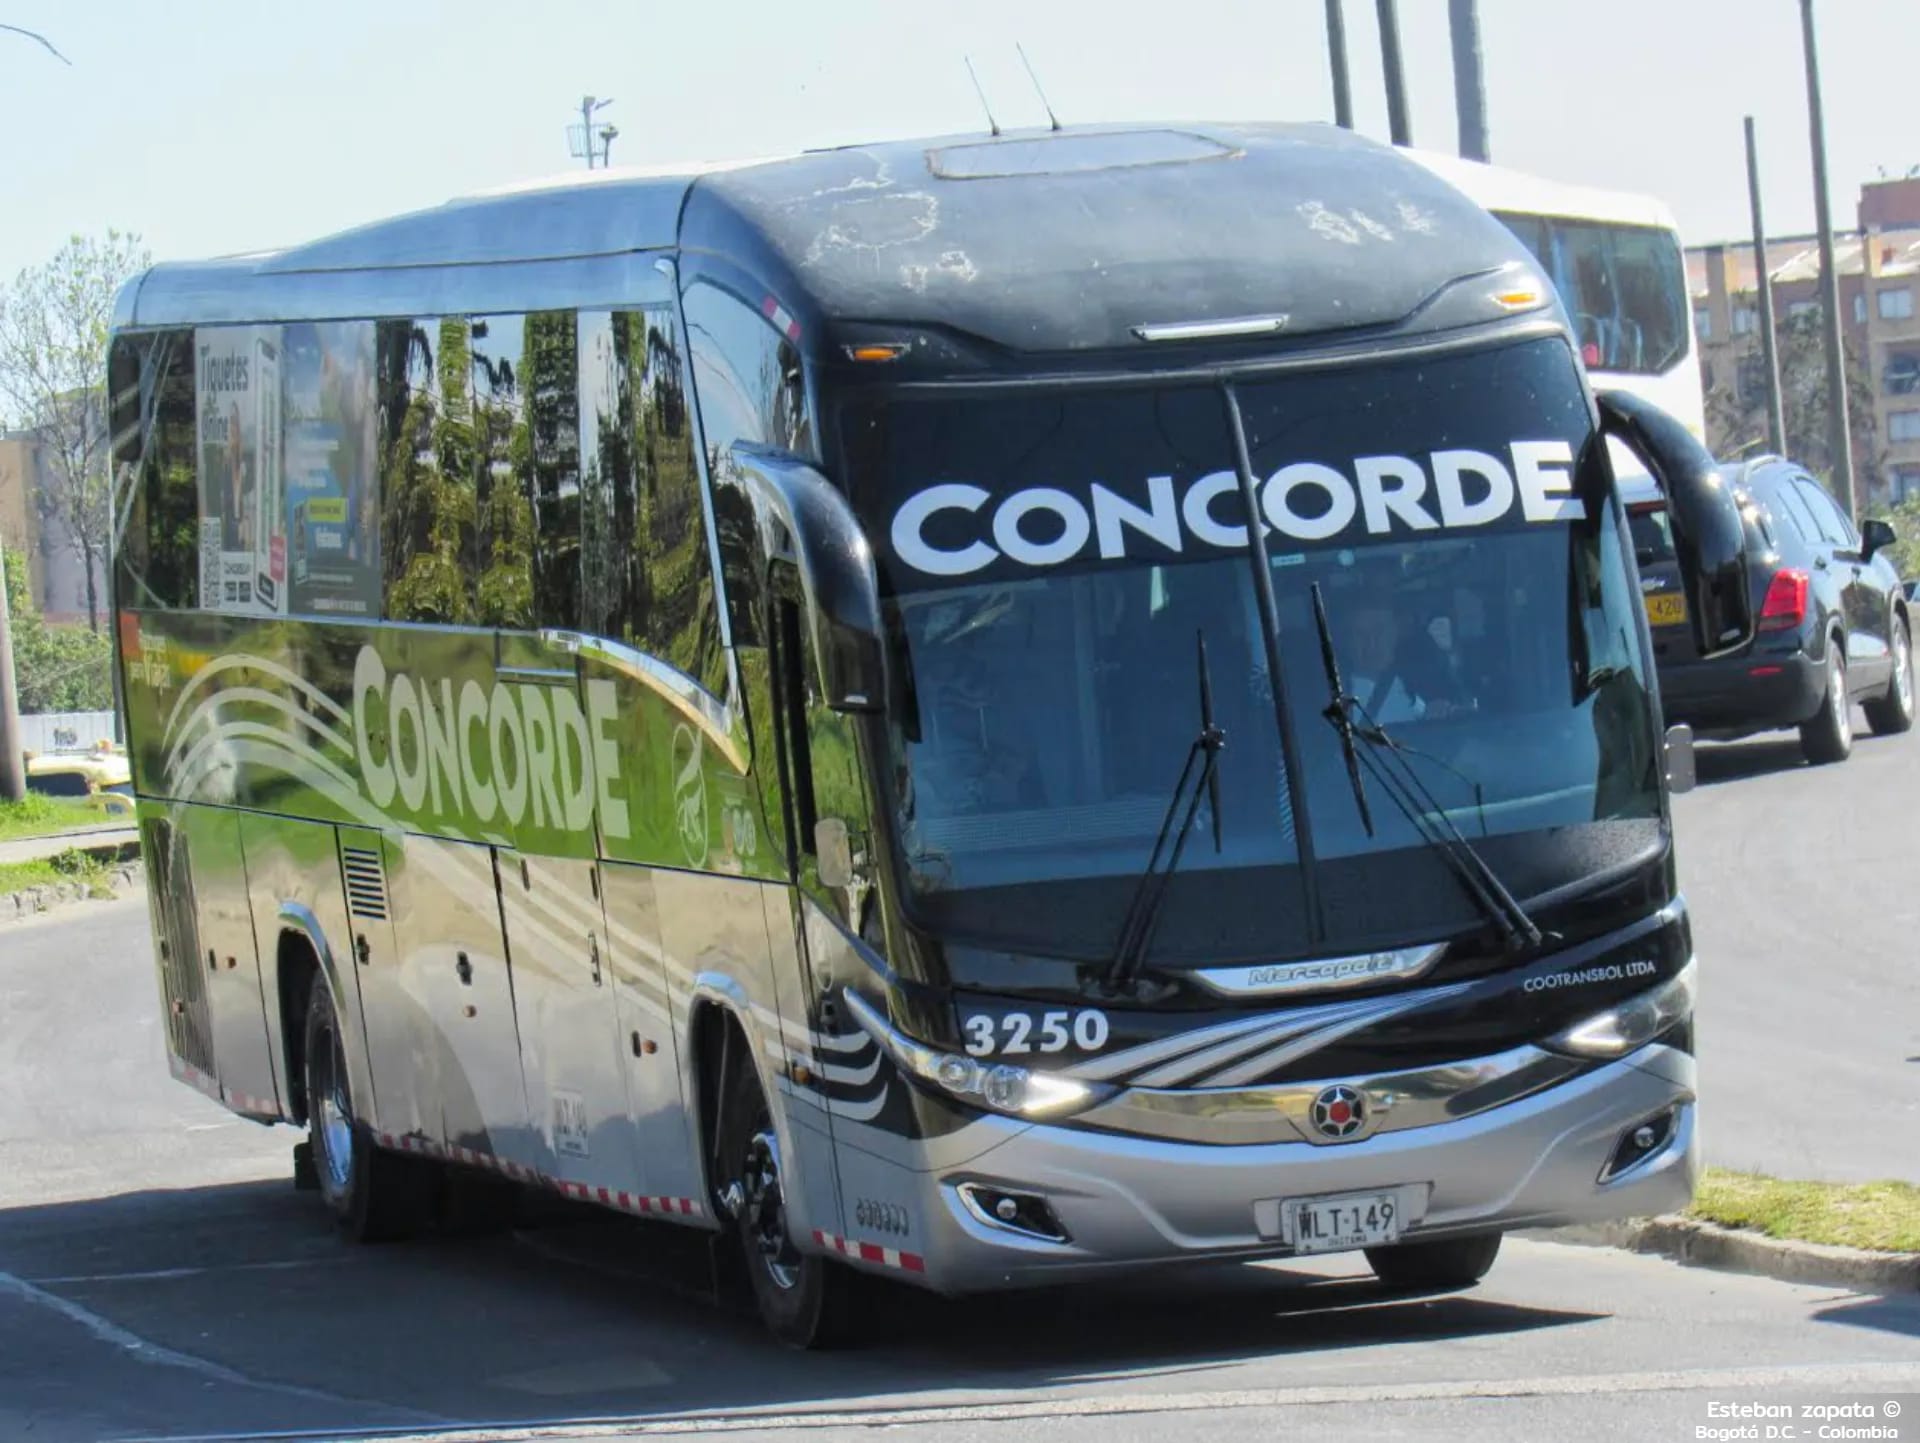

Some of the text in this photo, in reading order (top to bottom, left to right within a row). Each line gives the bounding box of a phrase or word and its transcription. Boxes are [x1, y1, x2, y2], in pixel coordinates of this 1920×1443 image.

[891, 440, 1587, 577] CONCORDE
[353, 645, 631, 840] CONCORDE
[1523, 959, 1657, 993] COOTRANSBOL LTDA
[965, 1008, 1109, 1057] 3250
